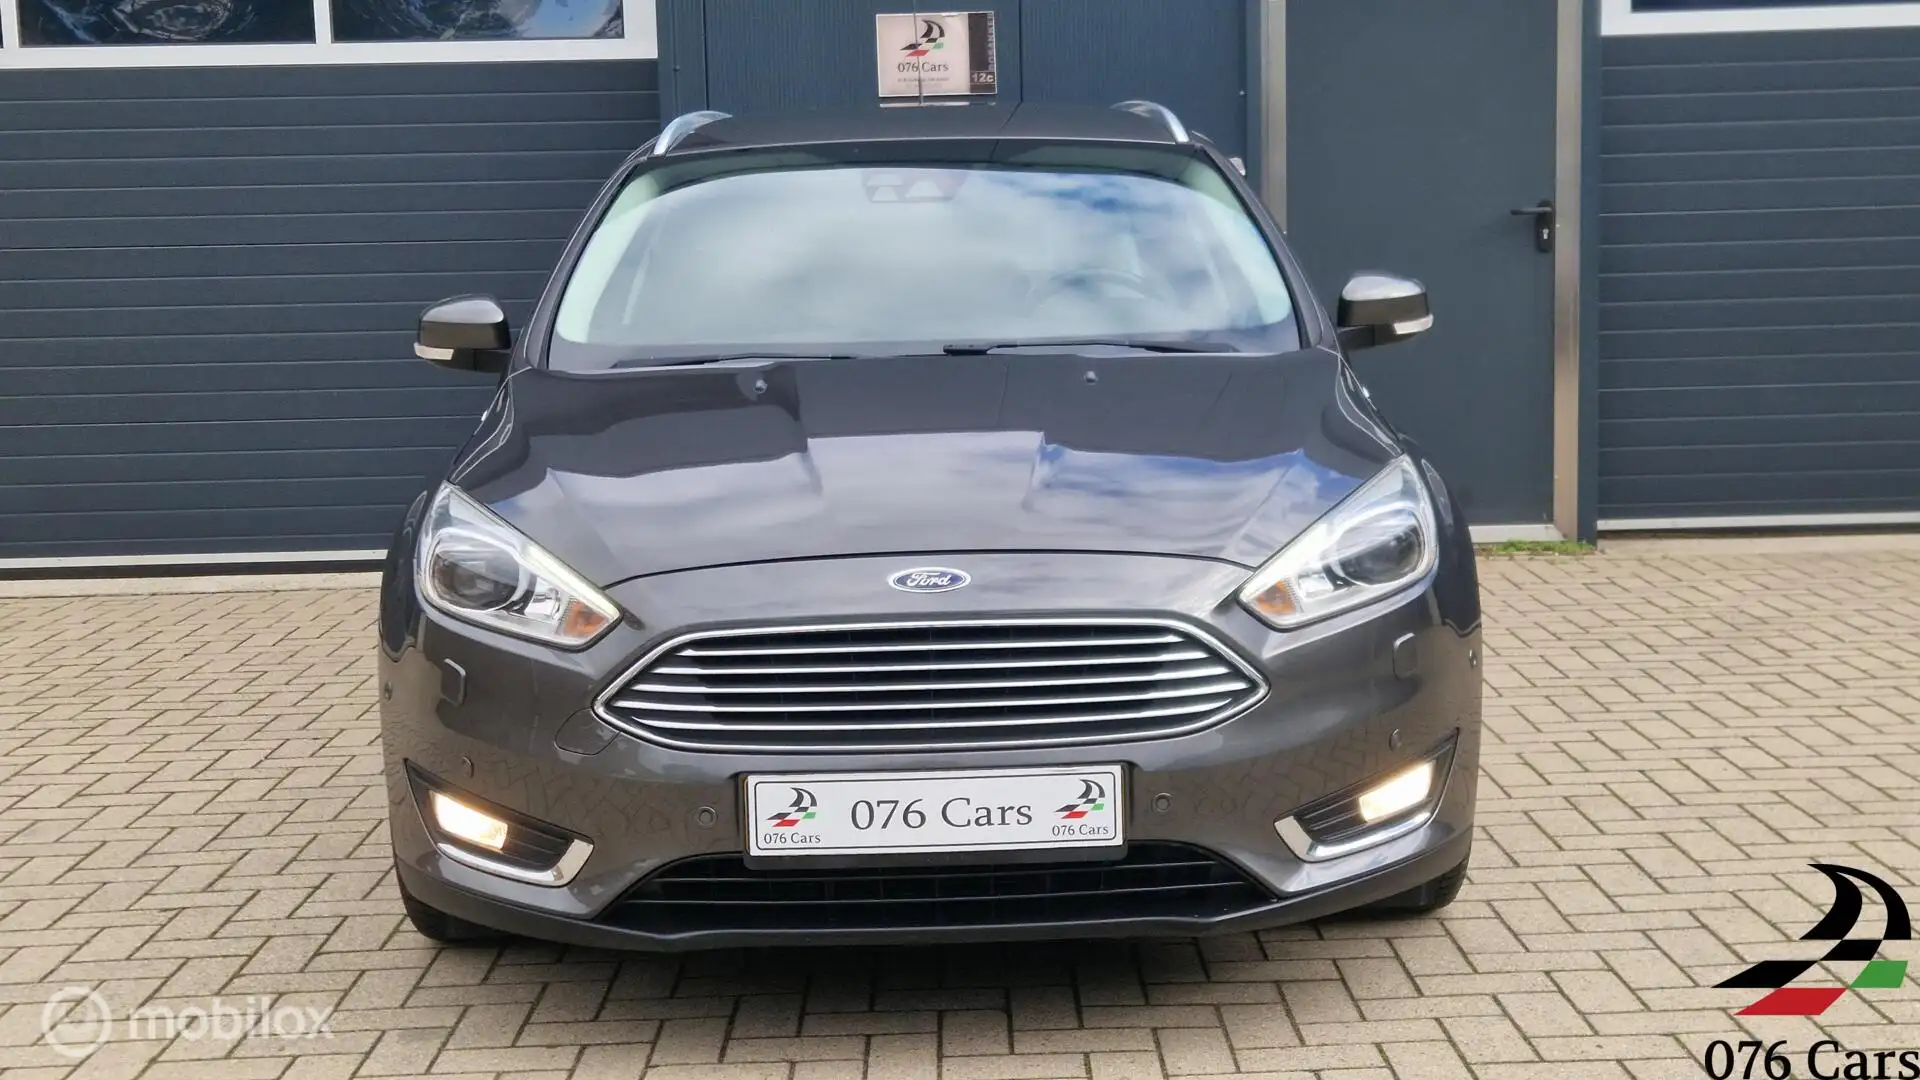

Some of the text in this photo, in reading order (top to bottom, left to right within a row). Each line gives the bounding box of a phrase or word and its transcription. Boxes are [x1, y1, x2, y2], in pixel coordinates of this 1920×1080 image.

[897, 61, 950, 73] 076 Cars
[906, 572, 952, 587] Ford
[851, 797, 1033, 830] 076 Cars
[1052, 824, 1109, 836] 076 Cars
[763, 832, 821, 844] 076 Cars
